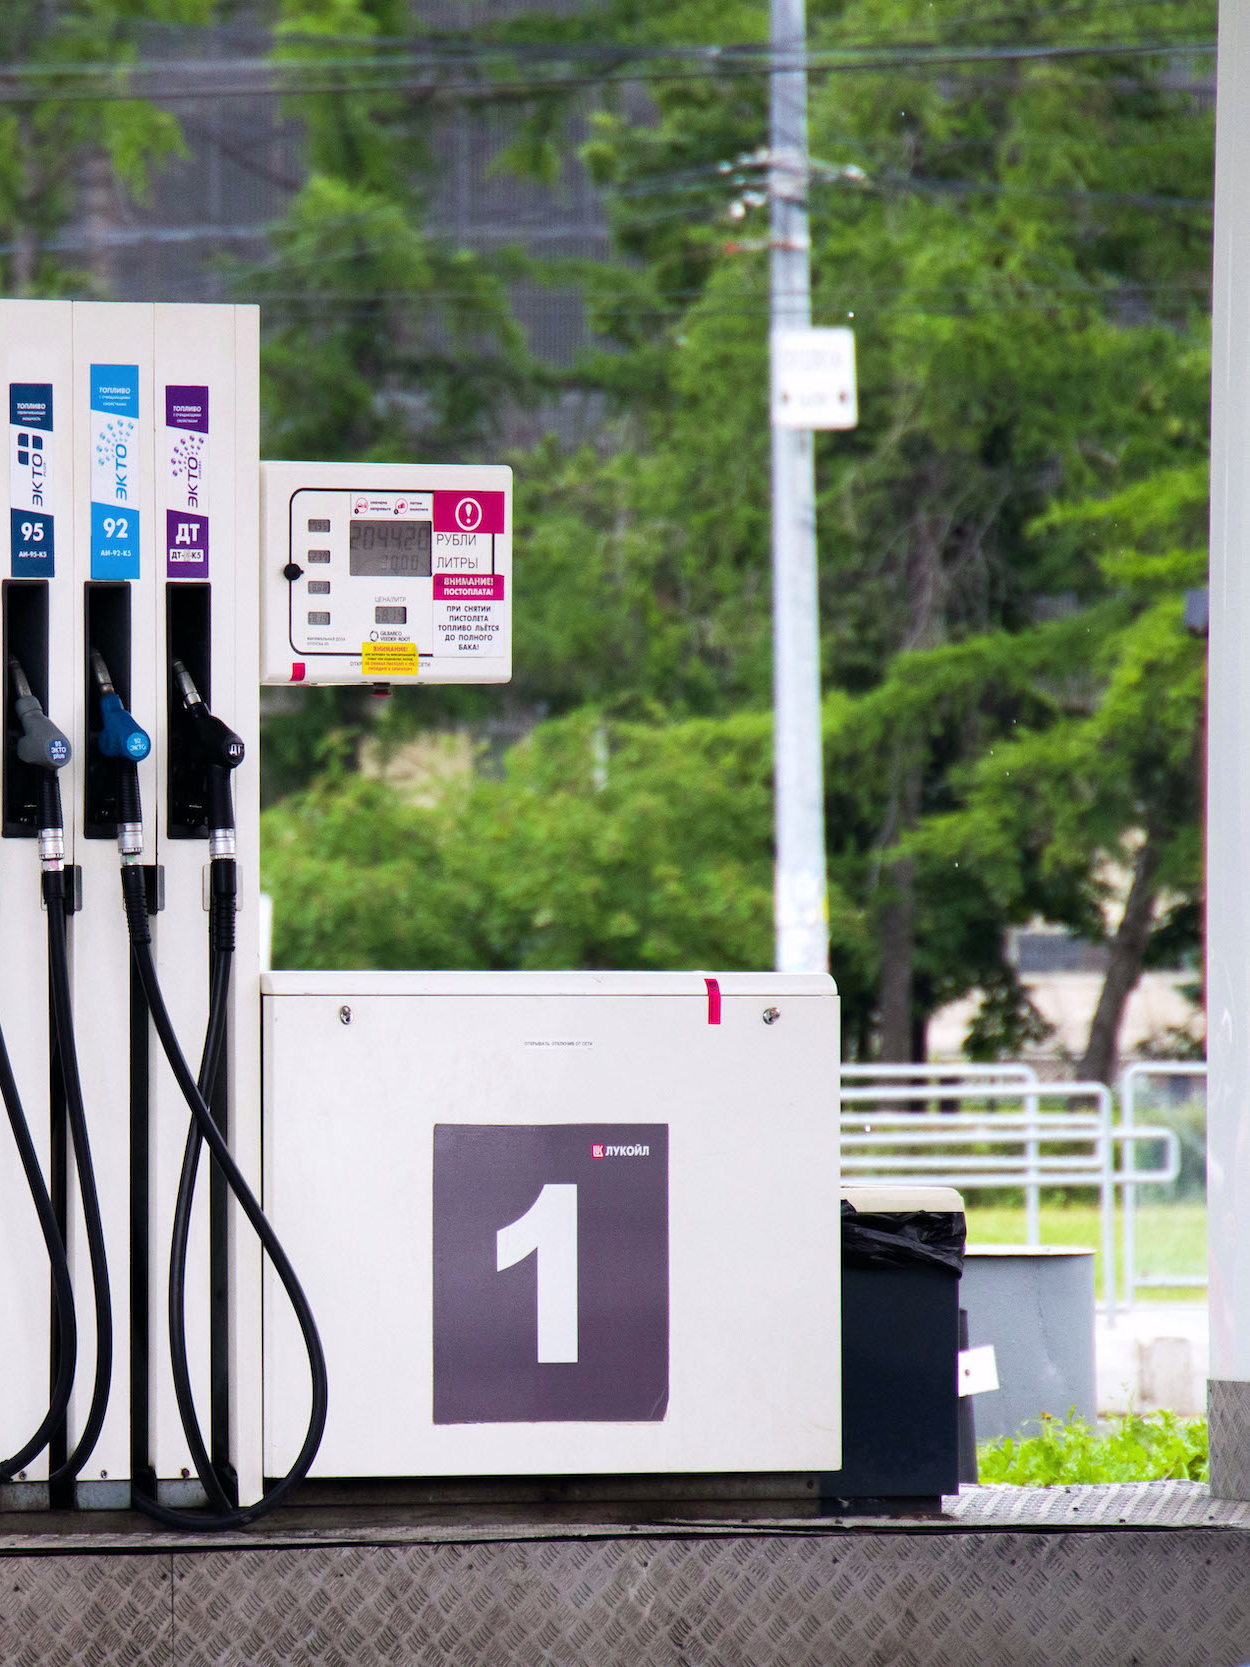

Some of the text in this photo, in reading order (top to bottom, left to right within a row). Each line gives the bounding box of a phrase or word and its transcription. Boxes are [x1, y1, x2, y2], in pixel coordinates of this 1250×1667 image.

[17, 402, 46, 410] ТОПЛИВО
[115, 443, 127, 501] ЭКТО
[32, 453, 43, 507] ЭКТО
[187, 456, 198, 508] ЭКТО
[21, 522, 45, 542] 95
[103, 518, 128, 538] 92
[175, 523, 201, 545] ДТ
[436, 533, 477, 546] РУБЛИ
[100, 549, 132, 557] АИ-92-К5
[436, 556, 478, 569] ЛИТРЫ
[443, 577, 494, 586] ВНИМАНИЕ!
[443, 588, 494, 596] ПОСТОПЛАТА!
[475, 623, 500, 631] ЛЬЁТСЯ
[444, 634, 455, 642] ДО
[229, 743, 242, 756] ДТ
[605, 1143, 650, 1157] ЛУКОЙЛ
[496, 1183, 579, 1364] 1
